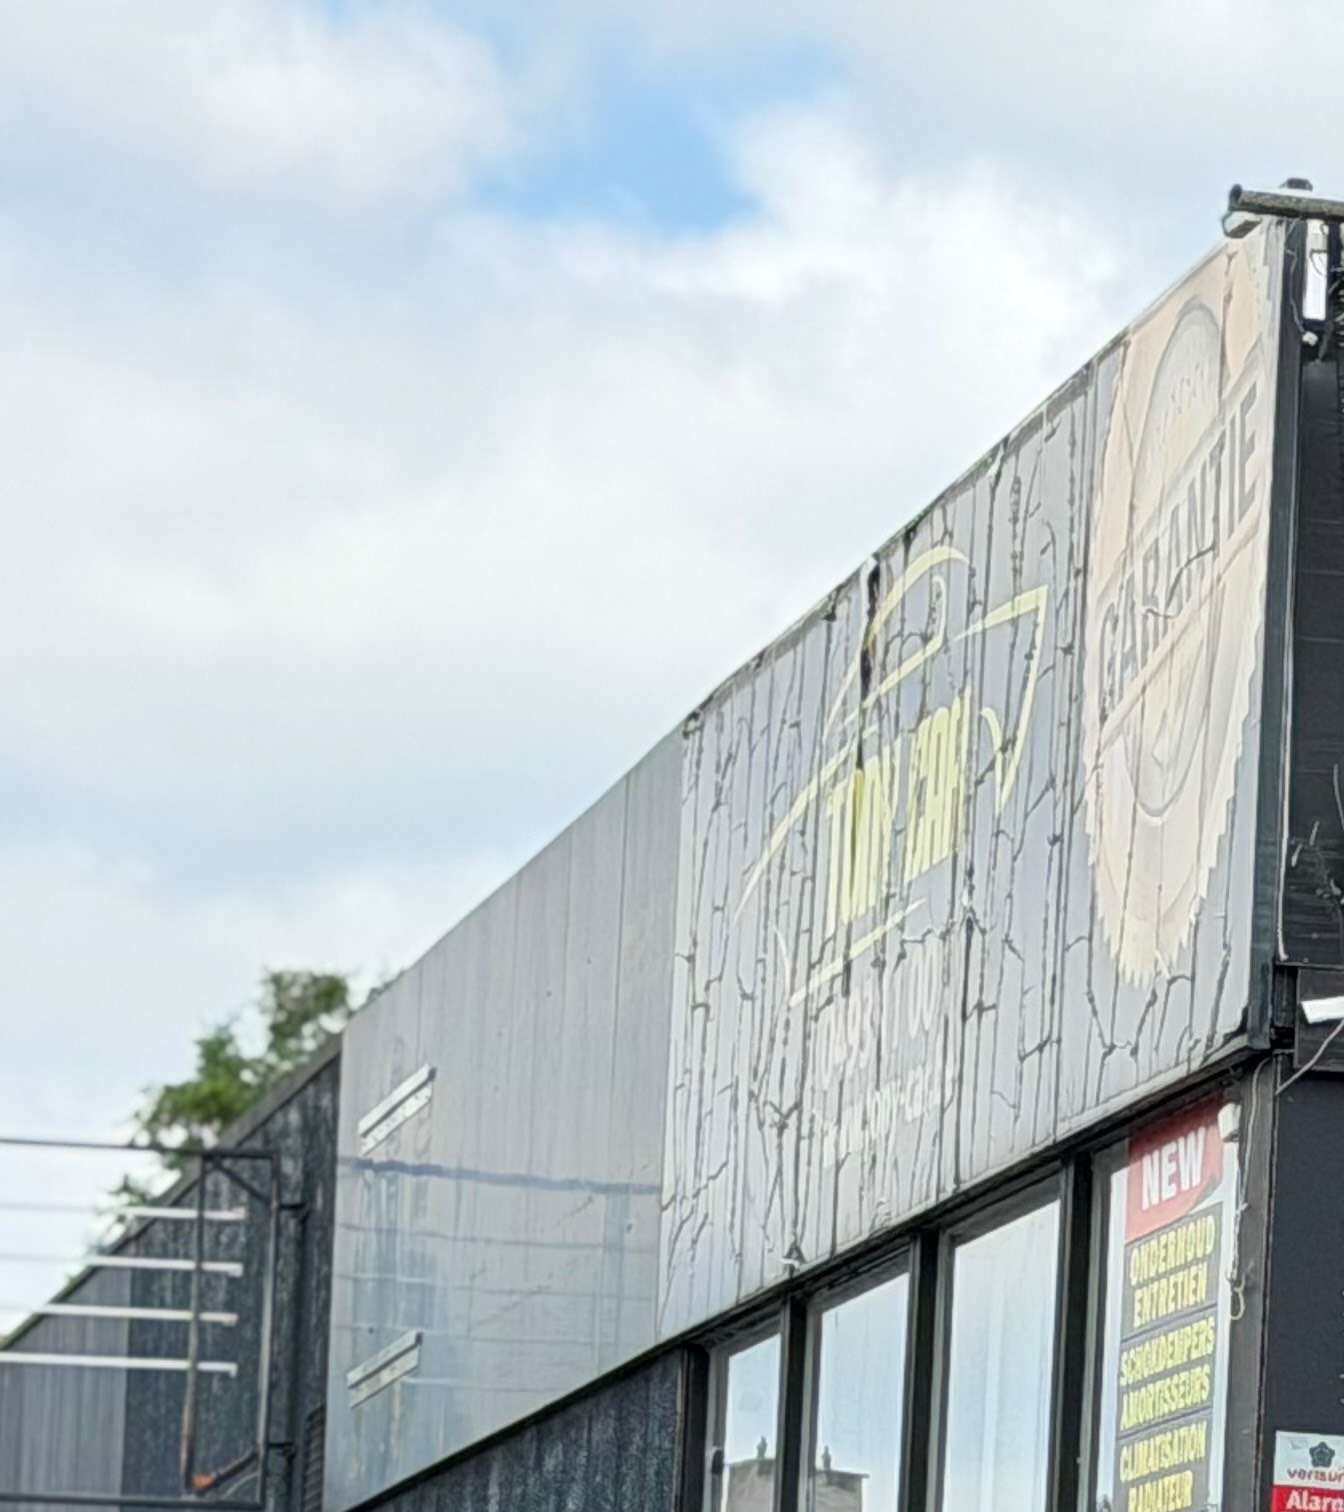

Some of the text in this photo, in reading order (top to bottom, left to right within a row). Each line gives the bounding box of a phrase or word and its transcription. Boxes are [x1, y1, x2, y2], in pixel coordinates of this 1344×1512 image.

[1141, 1128, 1206, 1211] NEW
[1129, 1215, 1216, 1286] ONDERHOUD
[1133, 1260, 1208, 1328] ENTRETIEN
